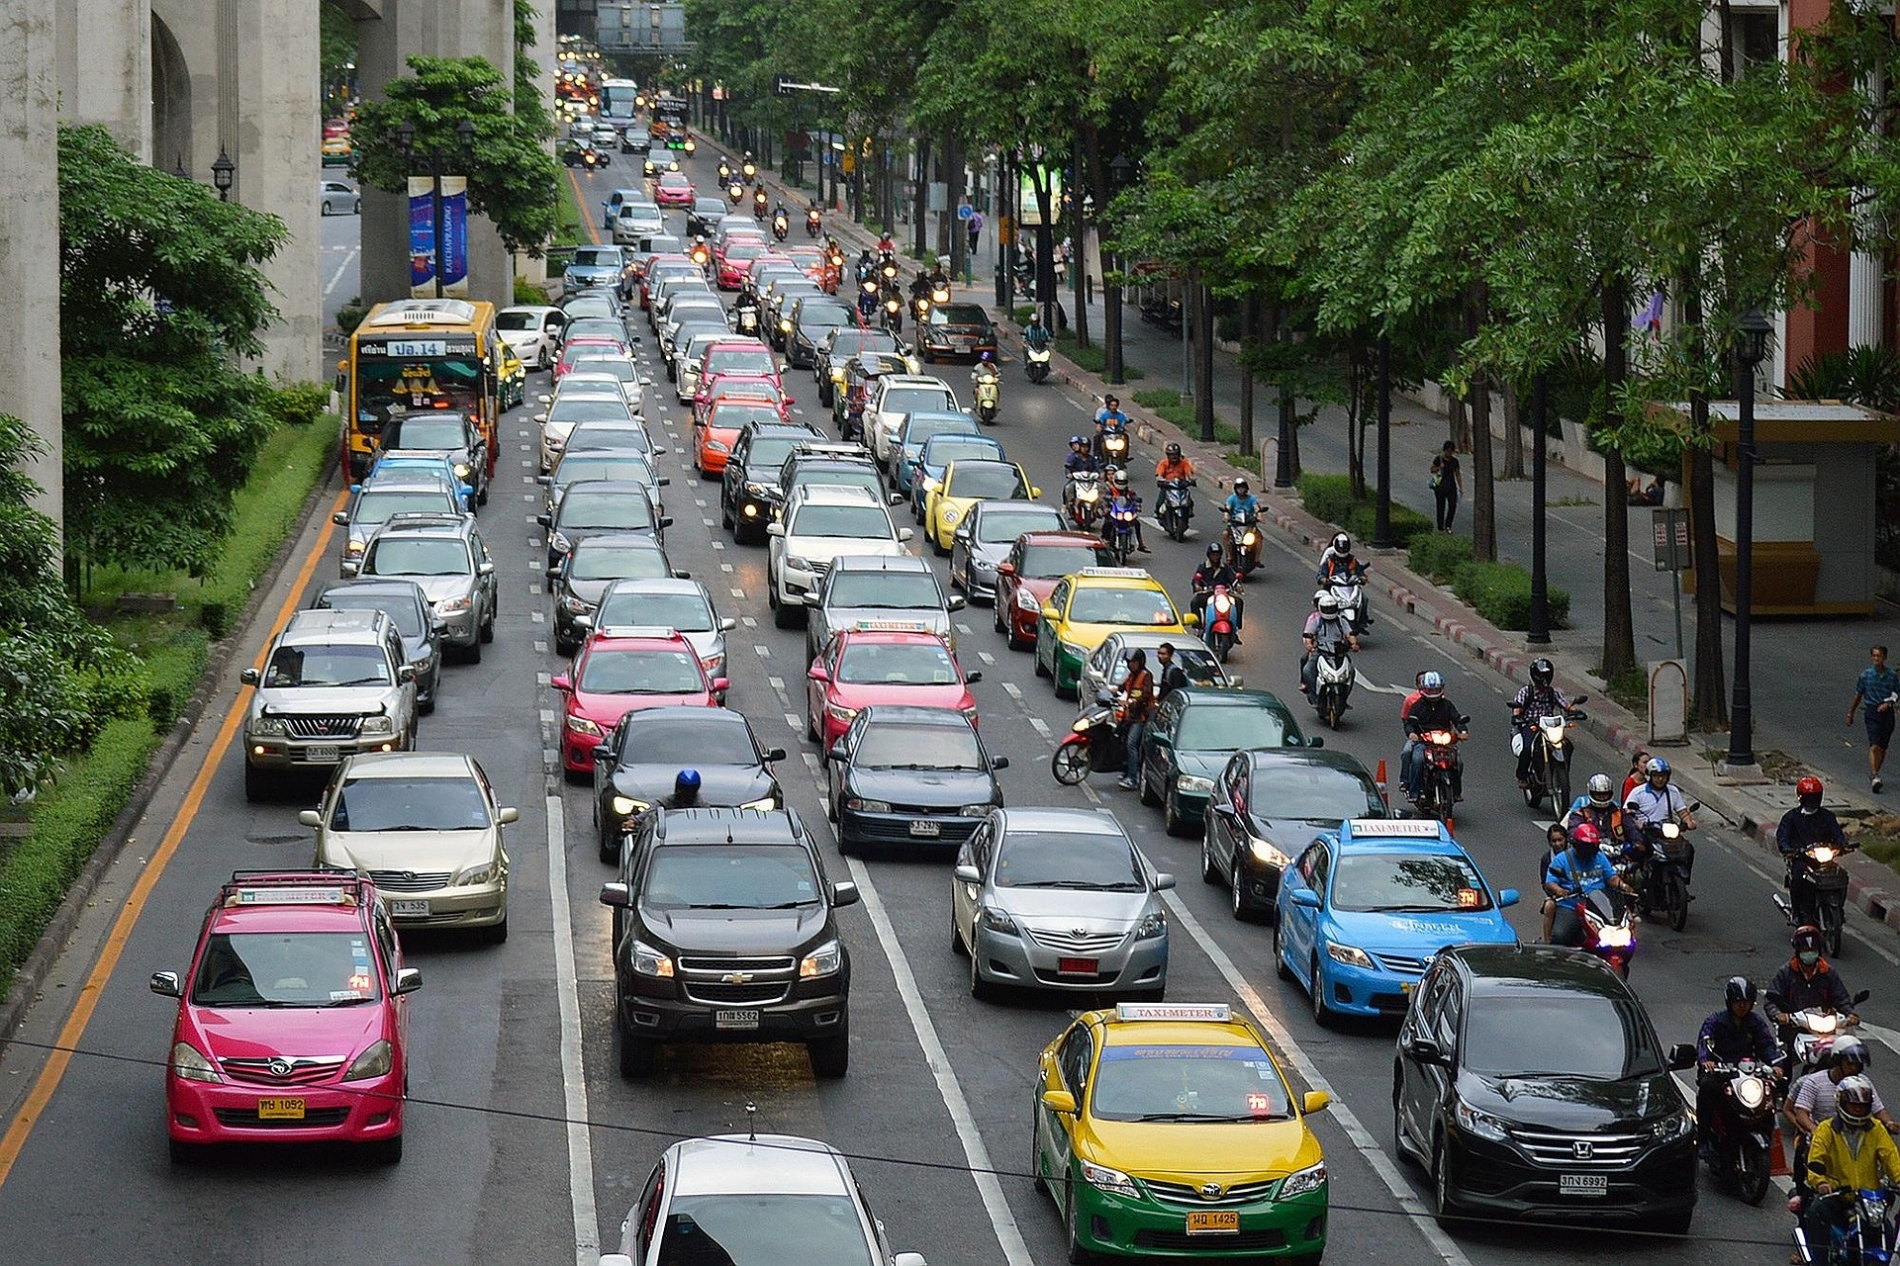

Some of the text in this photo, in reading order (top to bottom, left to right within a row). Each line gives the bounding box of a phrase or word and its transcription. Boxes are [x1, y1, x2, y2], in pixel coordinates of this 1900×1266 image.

[444, 205, 453, 274] RATCHAPRASONG
[394, 342, 437, 355] ปอ.14
[736, 1011, 758, 1020] 5562
[280, 1100, 304, 1110] 1052
[1582, 1176, 1606, 1187] 6992
[1213, 1214, 1236, 1224] 1425
